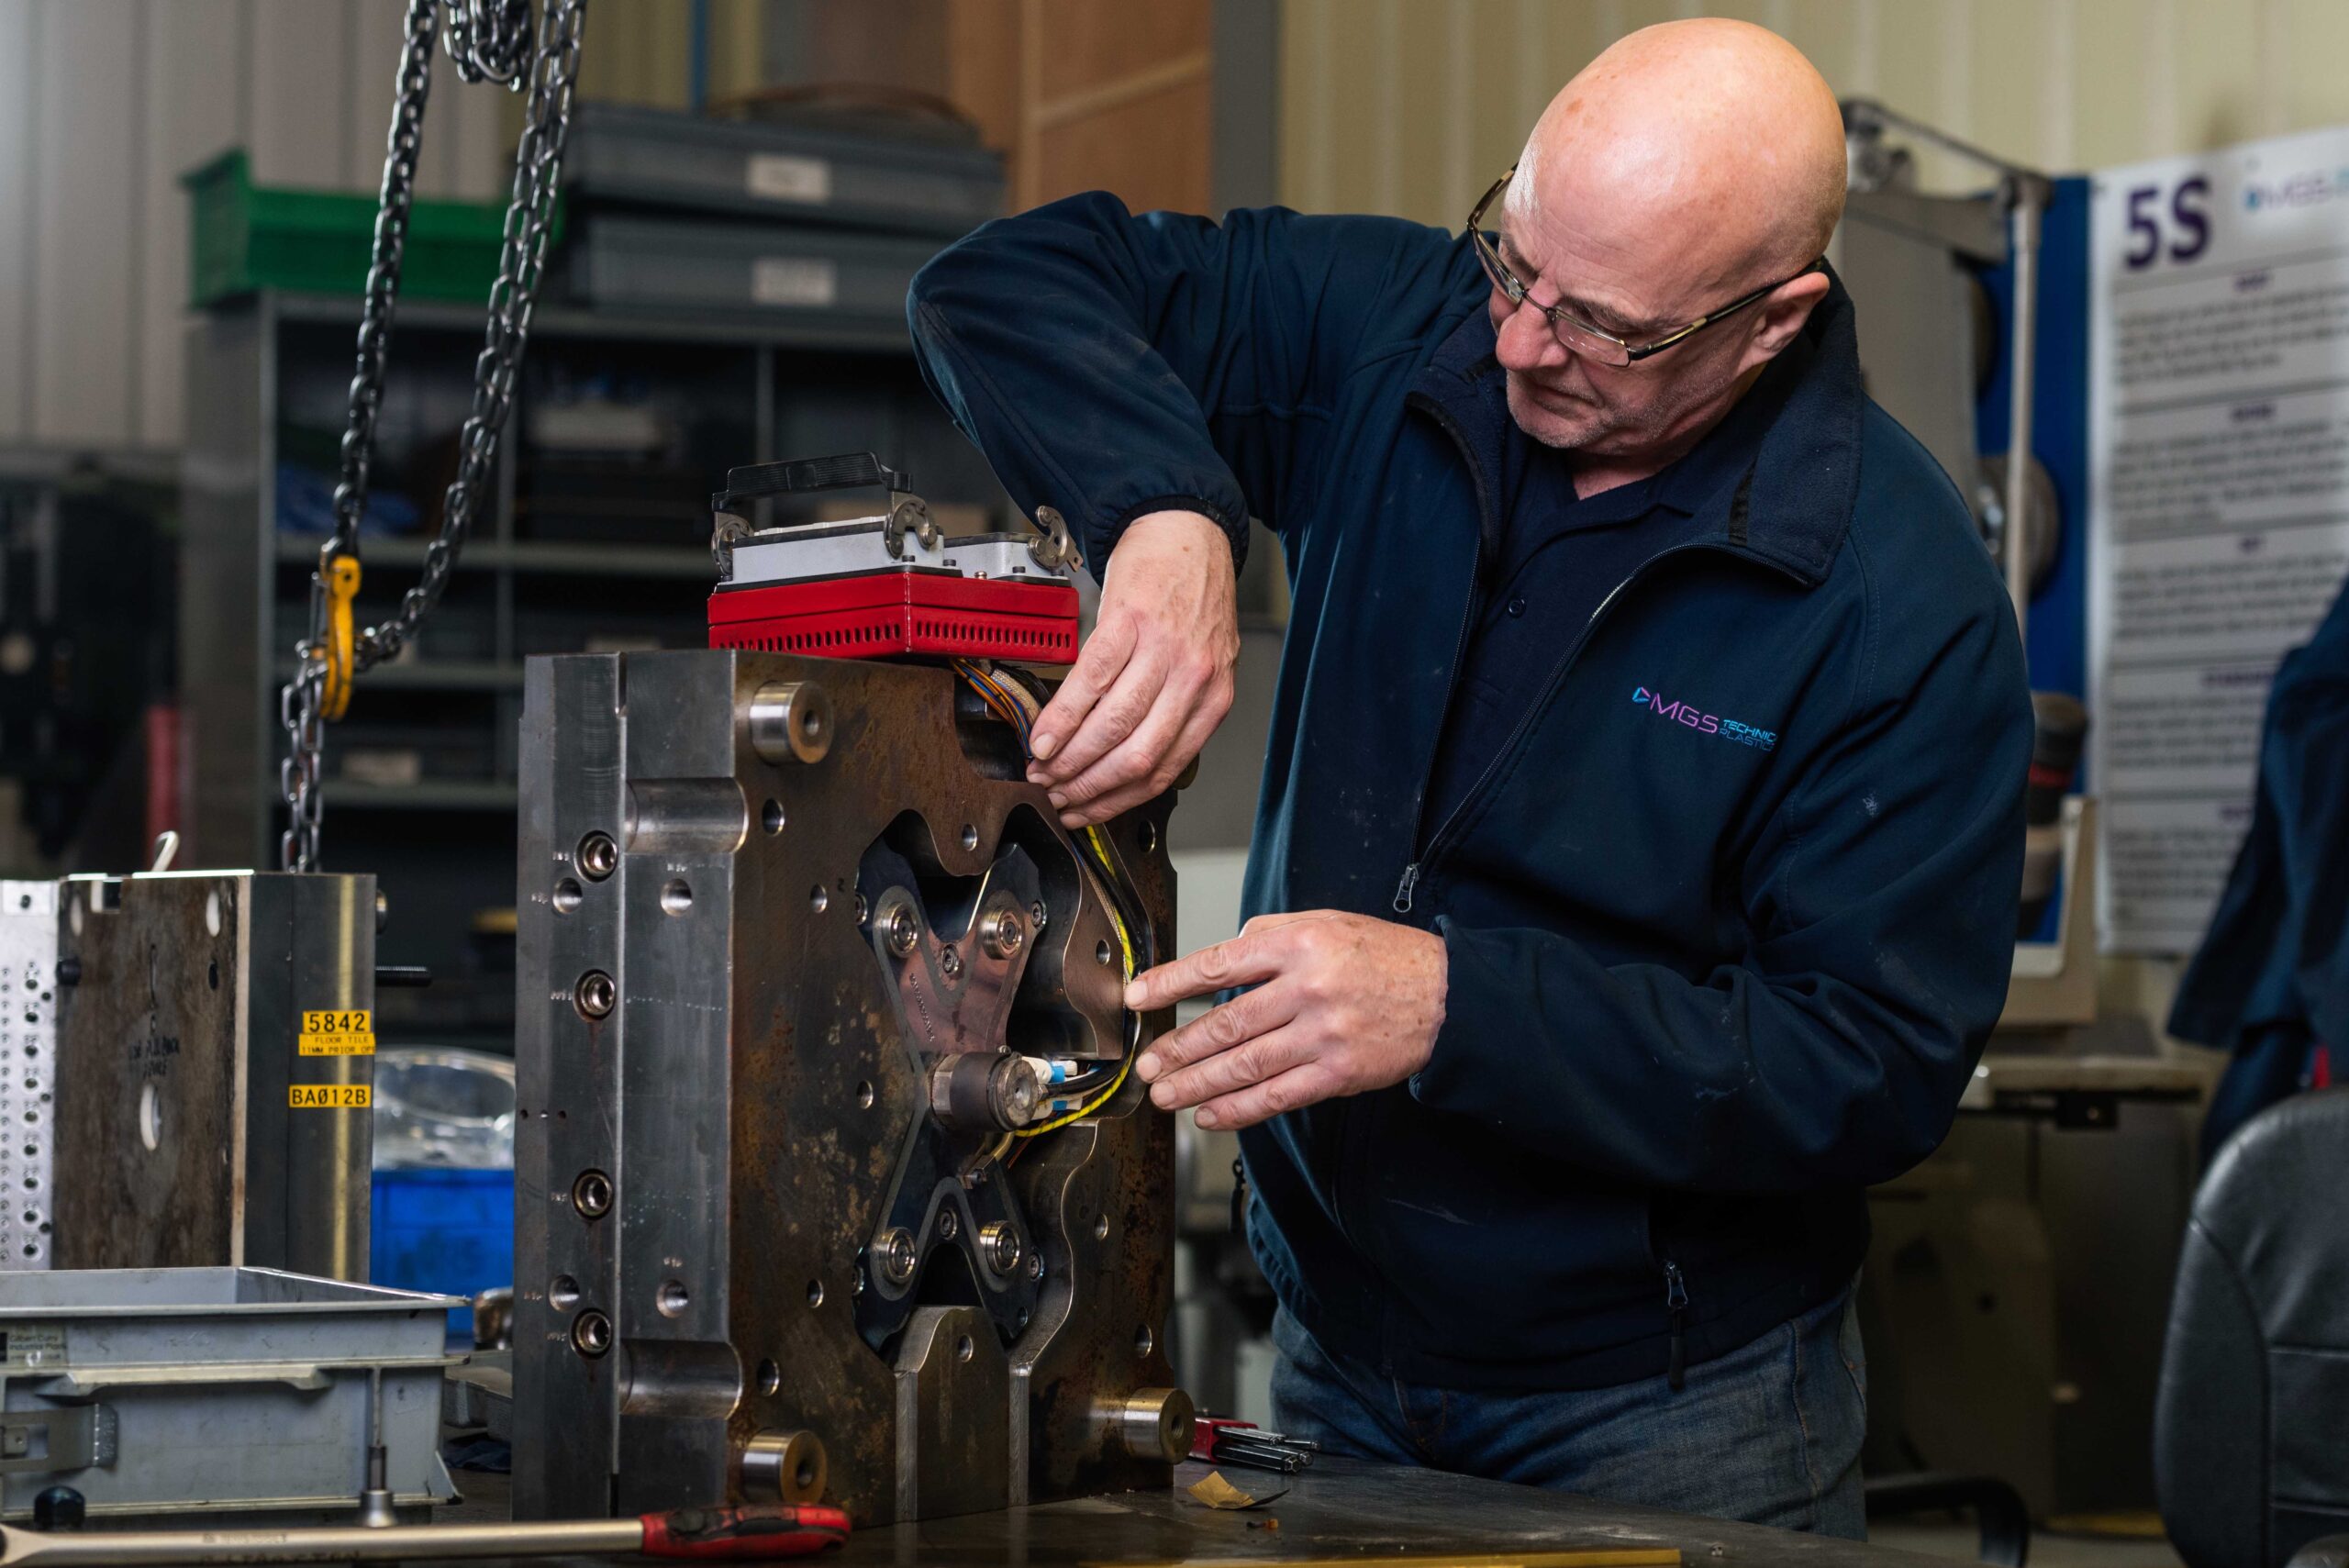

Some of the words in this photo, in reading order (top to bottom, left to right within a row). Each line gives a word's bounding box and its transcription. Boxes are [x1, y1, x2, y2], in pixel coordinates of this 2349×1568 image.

[2124, 176, 2212, 269] 5S
[1650, 693, 1719, 734] MGS
[309, 1013, 365, 1033] 5842
[315, 1036, 342, 1044] FLOOR
